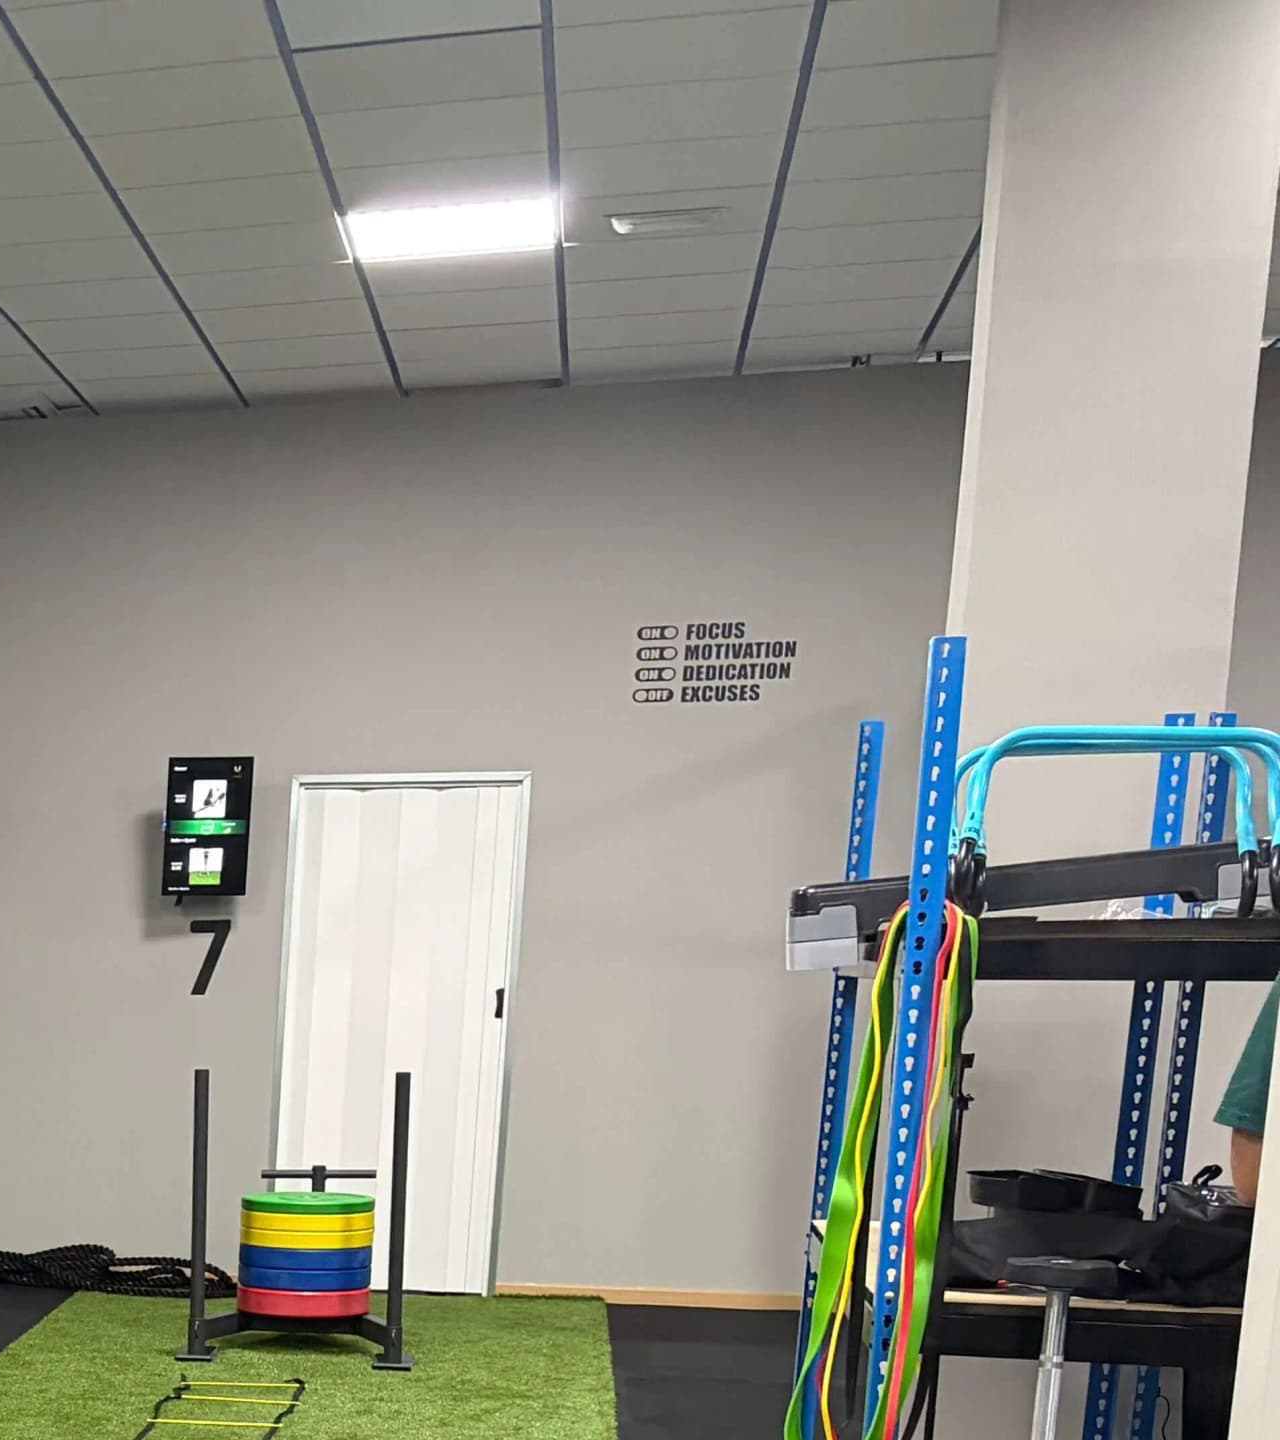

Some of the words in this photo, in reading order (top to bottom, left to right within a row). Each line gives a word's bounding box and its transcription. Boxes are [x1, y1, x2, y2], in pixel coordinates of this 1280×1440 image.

[686, 622, 745, 640] FOCUS
[684, 641, 797, 661] MOTIVATION
[682, 662, 791, 681] DEDICATION
[680, 684, 760, 703] EXCUSES
[190, 919, 231, 995] 7
